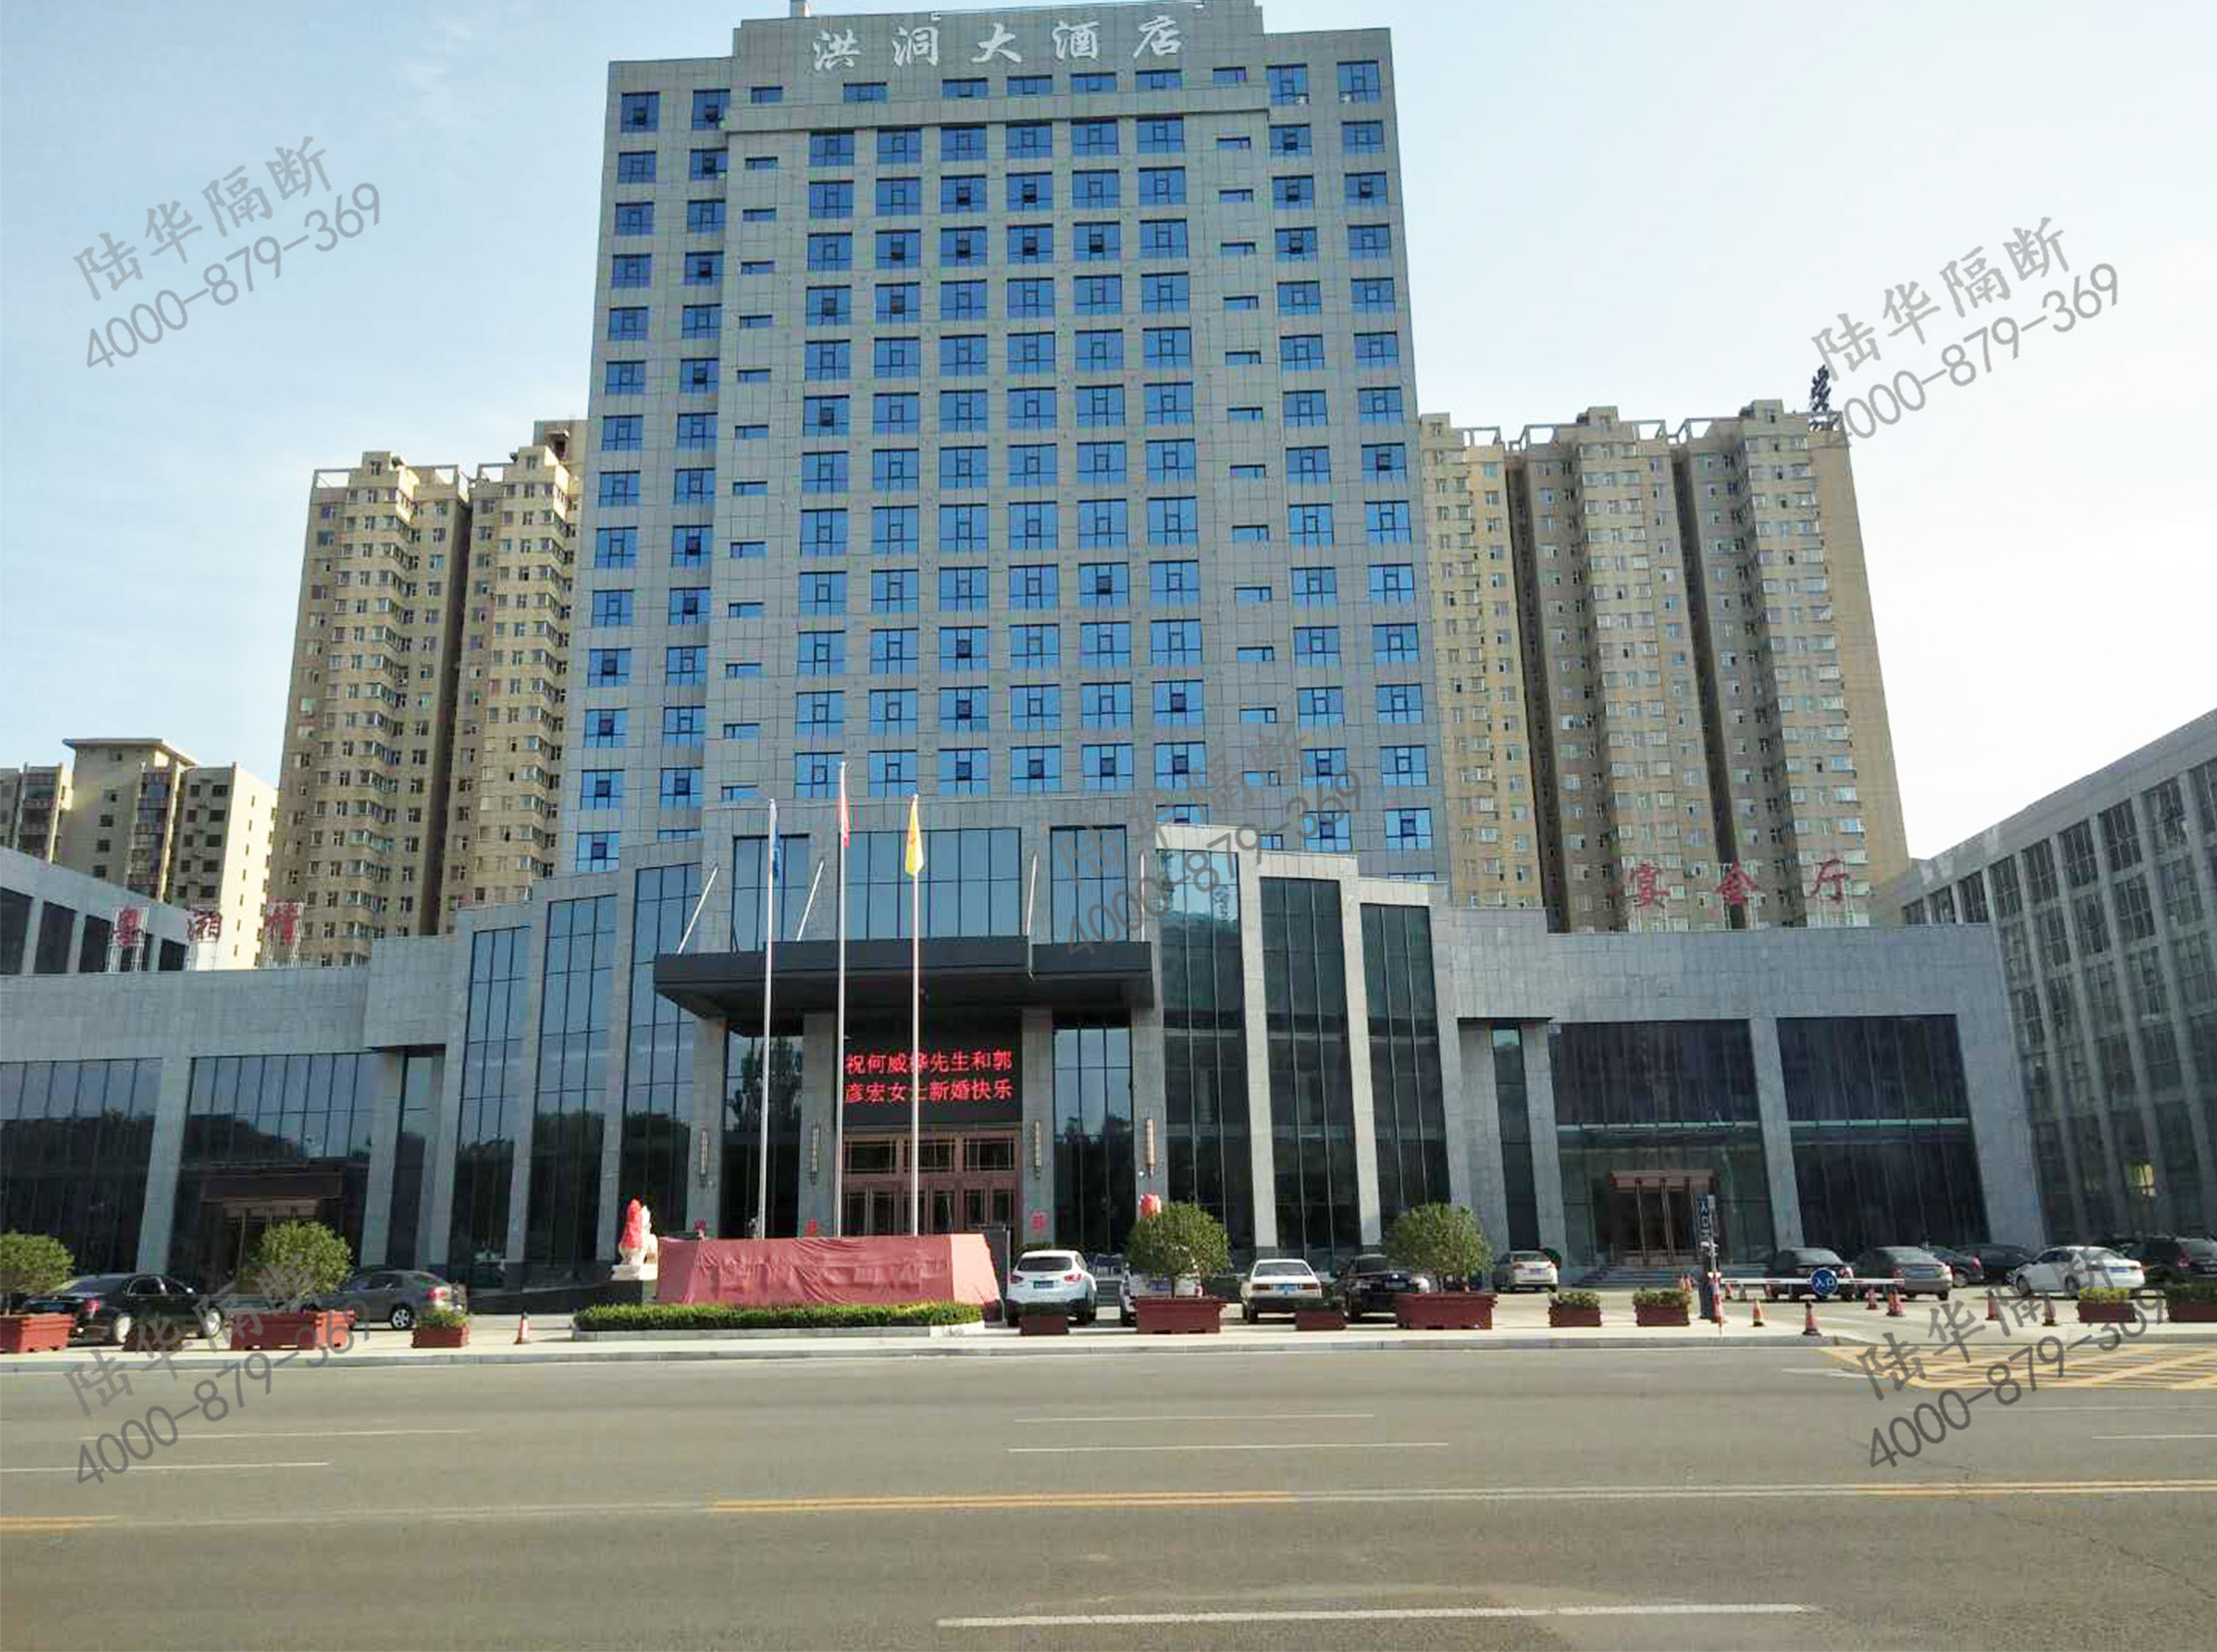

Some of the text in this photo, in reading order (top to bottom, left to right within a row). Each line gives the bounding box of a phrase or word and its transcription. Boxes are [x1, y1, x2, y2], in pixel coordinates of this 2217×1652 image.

[812, 15, 1183, 71] 洪洞大酒店
